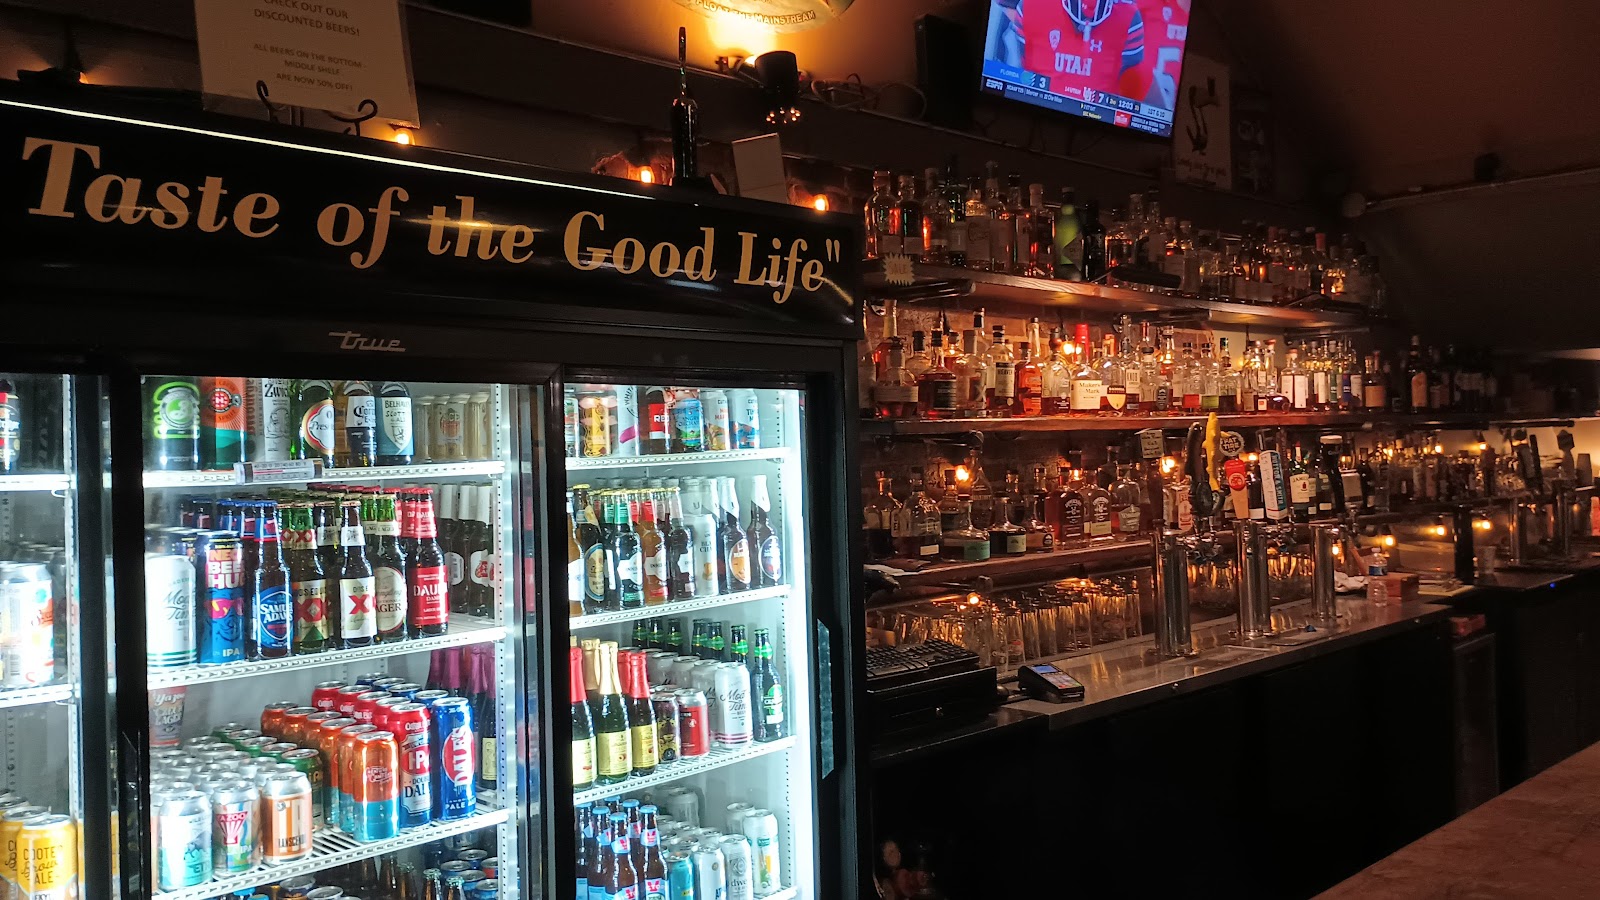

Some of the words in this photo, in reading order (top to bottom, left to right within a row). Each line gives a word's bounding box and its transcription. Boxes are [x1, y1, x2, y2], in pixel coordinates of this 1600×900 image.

[264, 0, 299, 9] CHECK
[301, 3, 323, 14] OUT
[326, 7, 349, 19] OUR
[254, 9, 323, 29] DISCOUNTED
[325, 21, 360, 36] BEERS!
[753, 9, 816, 26] MAINSTREAM
[253, 43, 267, 51] ALL
[270, 46, 295, 58] BEERS
[297, 50, 310, 58] ON
[311, 52, 326, 62] THE
[327, 56, 362, 68] BOTTOM
[284, 60, 316, 71] MIDDLE
[317, 66, 341, 75] SHELF
[1055, 52, 1093, 76] UTAH
[276, 73, 292, 81] ARE
[294, 76, 316, 85] NOW
[316, 79, 334, 89] 50%
[335, 82, 354, 91] OFF!
[986, 79, 1004, 91] ESPN
[1039, 77, 1047, 88] 3
[1098, 92, 1105, 104] 7
[22, 136, 281, 239] Taste
[316, 186, 409, 270] of
[426, 195, 535, 264] the
[562, 210, 718, 284] Good
[735, 229, 843, 305] Life"
[328, 330, 407, 353] true
[1222, 442, 1240, 450] TIRE
[1223, 436, 1238, 444] FAT
[376, 602, 402, 614] AGER
[222, 648, 240, 657] IPA
[452, 727, 474, 788] DALE'S
[445, 801, 466, 811] PALE
[34, 871, 54, 885] ALE
